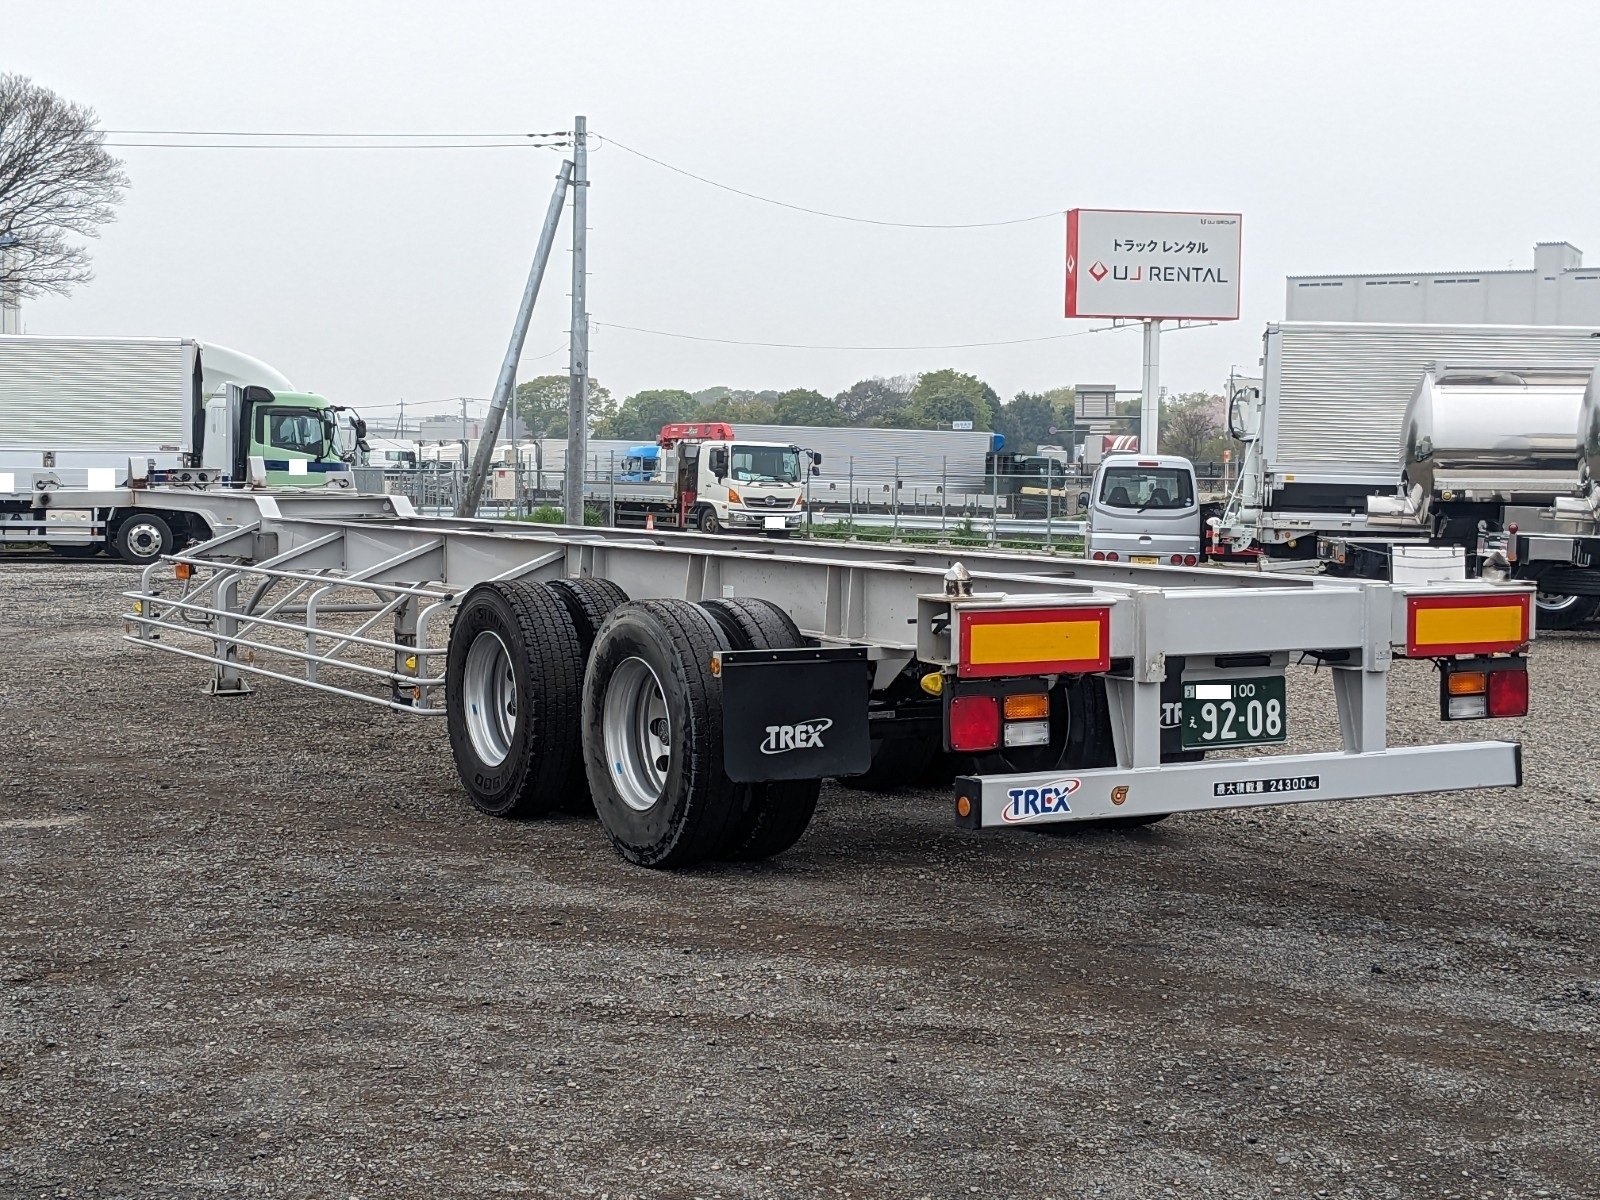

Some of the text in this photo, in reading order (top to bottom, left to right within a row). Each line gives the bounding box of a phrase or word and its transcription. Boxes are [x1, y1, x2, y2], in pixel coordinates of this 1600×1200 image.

[1113, 239, 1209, 254] トラック レンタル
[1113, 265, 1229, 283] UJ RENTAL
[1233, 683, 1256, 698] 100
[1201, 698, 1282, 741] 92-08
[765, 723, 826, 750] TREX
[1216, 781, 1264, 795] 最大積載量
[1007, 785, 1073, 817] TREX
